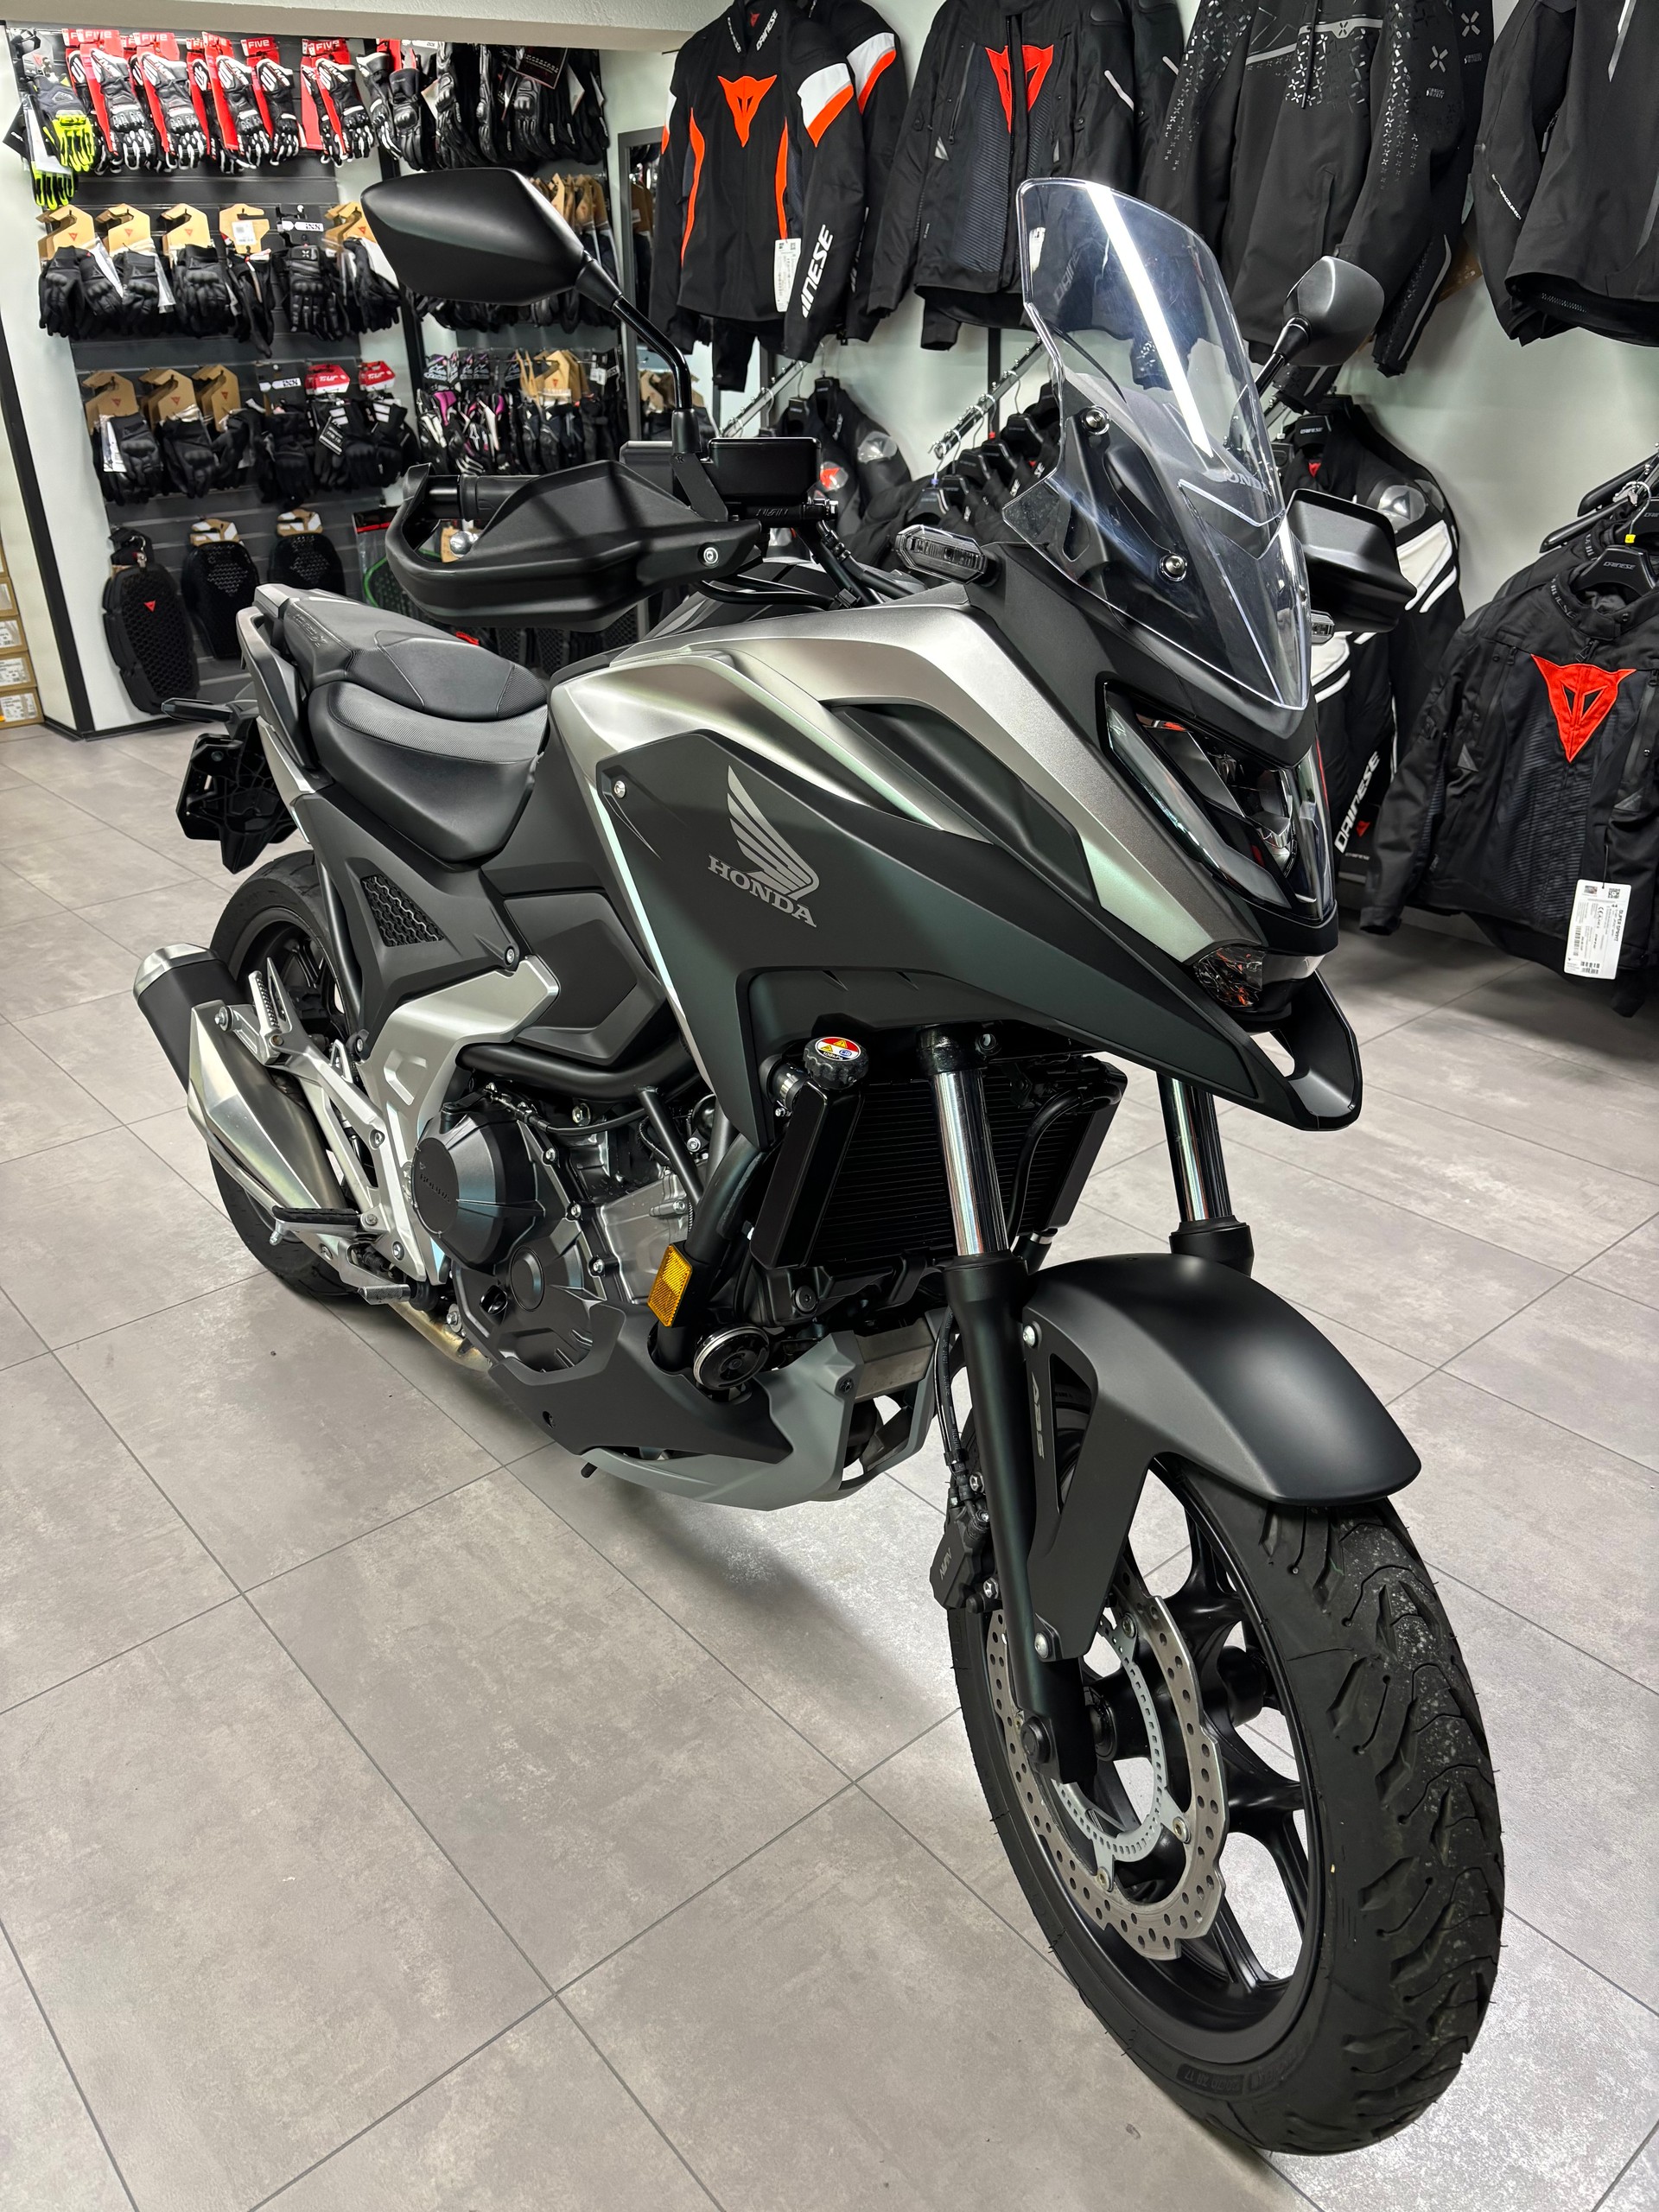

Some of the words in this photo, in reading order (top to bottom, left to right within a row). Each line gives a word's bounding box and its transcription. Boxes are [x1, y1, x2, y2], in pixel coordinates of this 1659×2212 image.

[85, 30, 112, 39] FIVE
[755, 9, 779, 51] DAINESE
[248, 40, 270, 48] FIVE
[316, 40, 340, 52] FIVE
[1603, 561, 1637, 570] DAINESE
[1334, 751, 1381, 854] DAINESE
[708, 854, 817, 928] HONDA
[1031, 1372, 1045, 1459] ABS
[1184, 2069, 1194, 2082] 17
